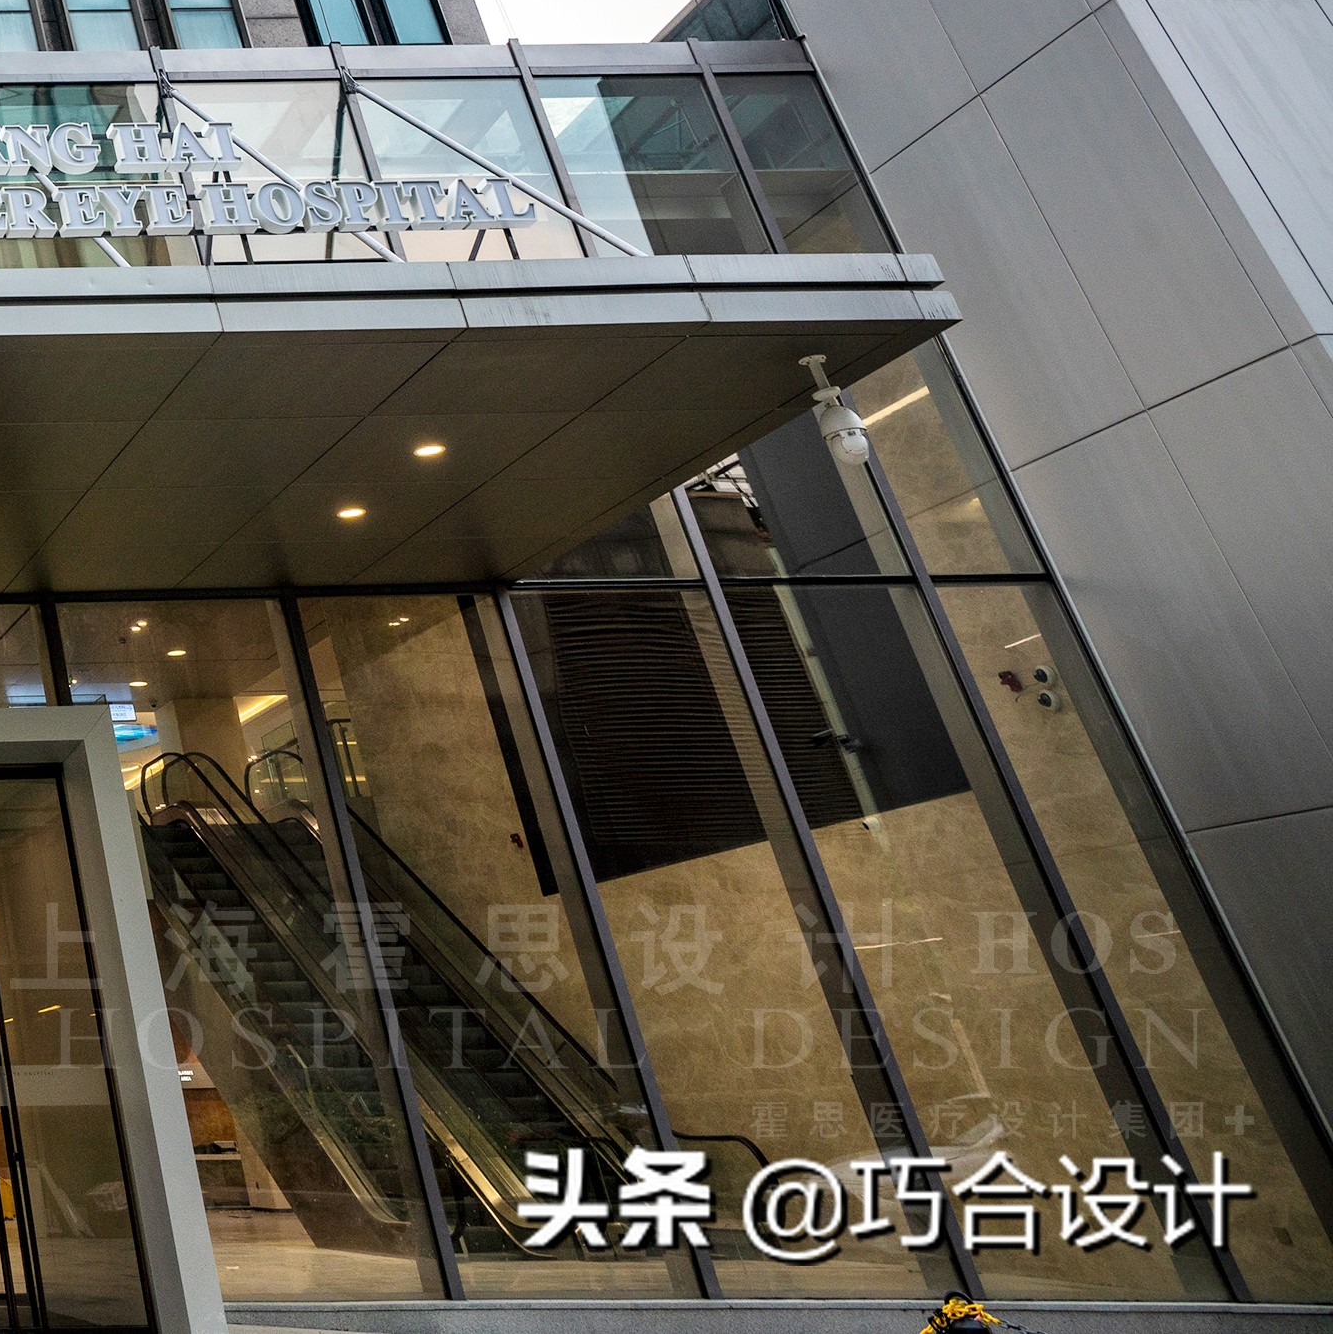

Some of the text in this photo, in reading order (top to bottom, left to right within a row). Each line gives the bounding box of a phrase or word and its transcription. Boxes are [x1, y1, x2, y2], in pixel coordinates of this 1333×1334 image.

[106, 122, 243, 173] HAI
[52, 184, 194, 237] EYE
[197, 177, 537, 234] HOSPITAL
